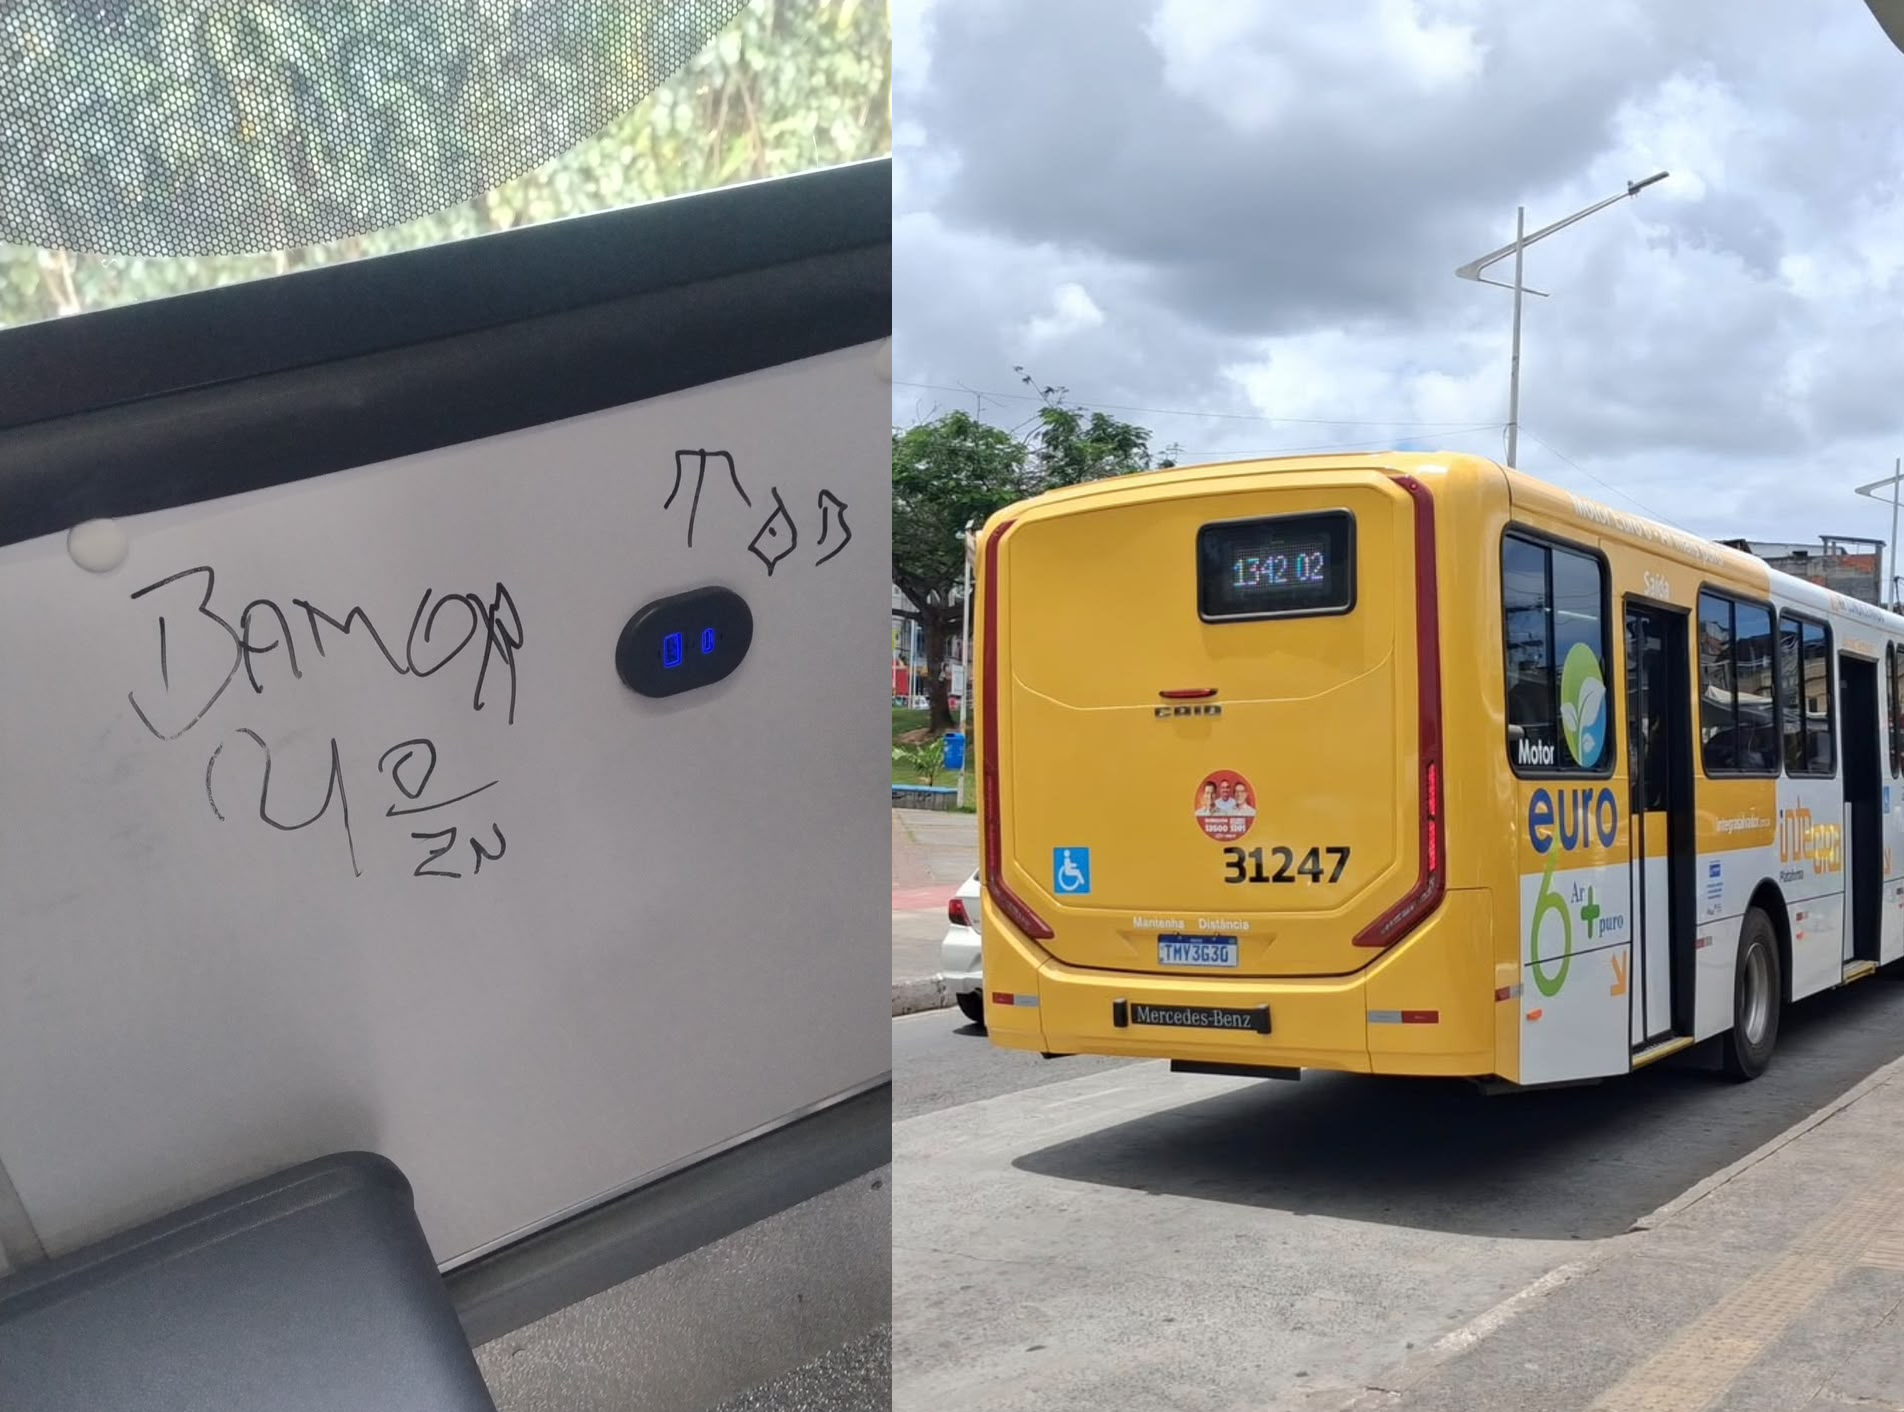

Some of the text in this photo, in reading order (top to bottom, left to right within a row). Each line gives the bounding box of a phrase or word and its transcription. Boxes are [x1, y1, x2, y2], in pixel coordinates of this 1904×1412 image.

[1233, 551, 1324, 586] 1342 02
[1518, 739, 1555, 766] Motor
[1528, 787, 1619, 854] euro
[1223, 846, 1351, 884] 31247
[1132, 916, 1185, 929] Mantenha
[1570, 880, 1585, 903] Ar
[1599, 914, 1624, 938] puro
[1136, 1005, 1252, 1028] Mercedes-Benz
